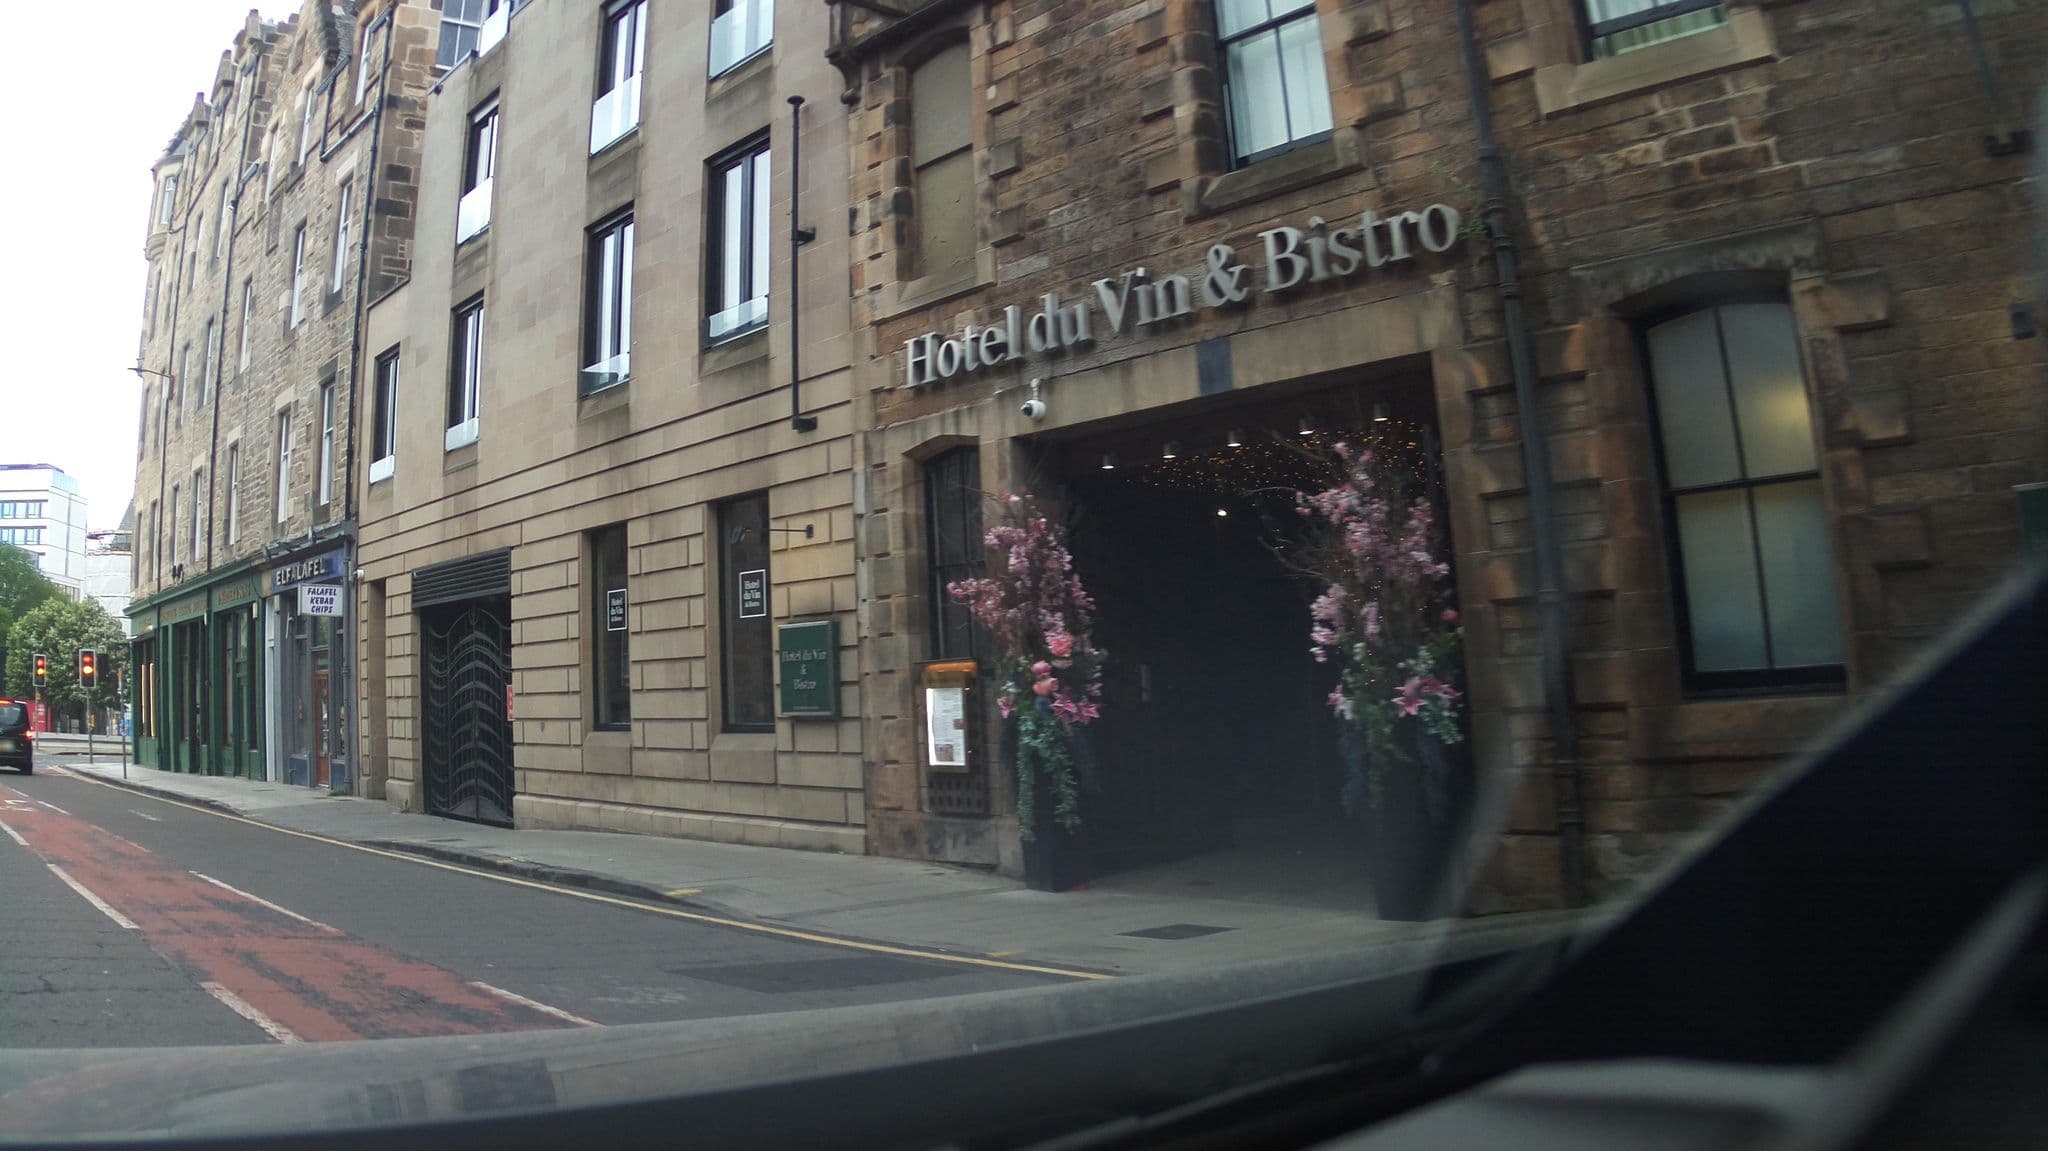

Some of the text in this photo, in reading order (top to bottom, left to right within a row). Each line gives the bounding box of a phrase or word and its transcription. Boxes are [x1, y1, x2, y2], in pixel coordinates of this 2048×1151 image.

[904, 202, 1462, 389] Hotel du Vin & Bistro
[307, 587, 337, 596] FALAFEL
[309, 596, 335, 605] KEBAB
[311, 605, 333, 614] CHIPS
